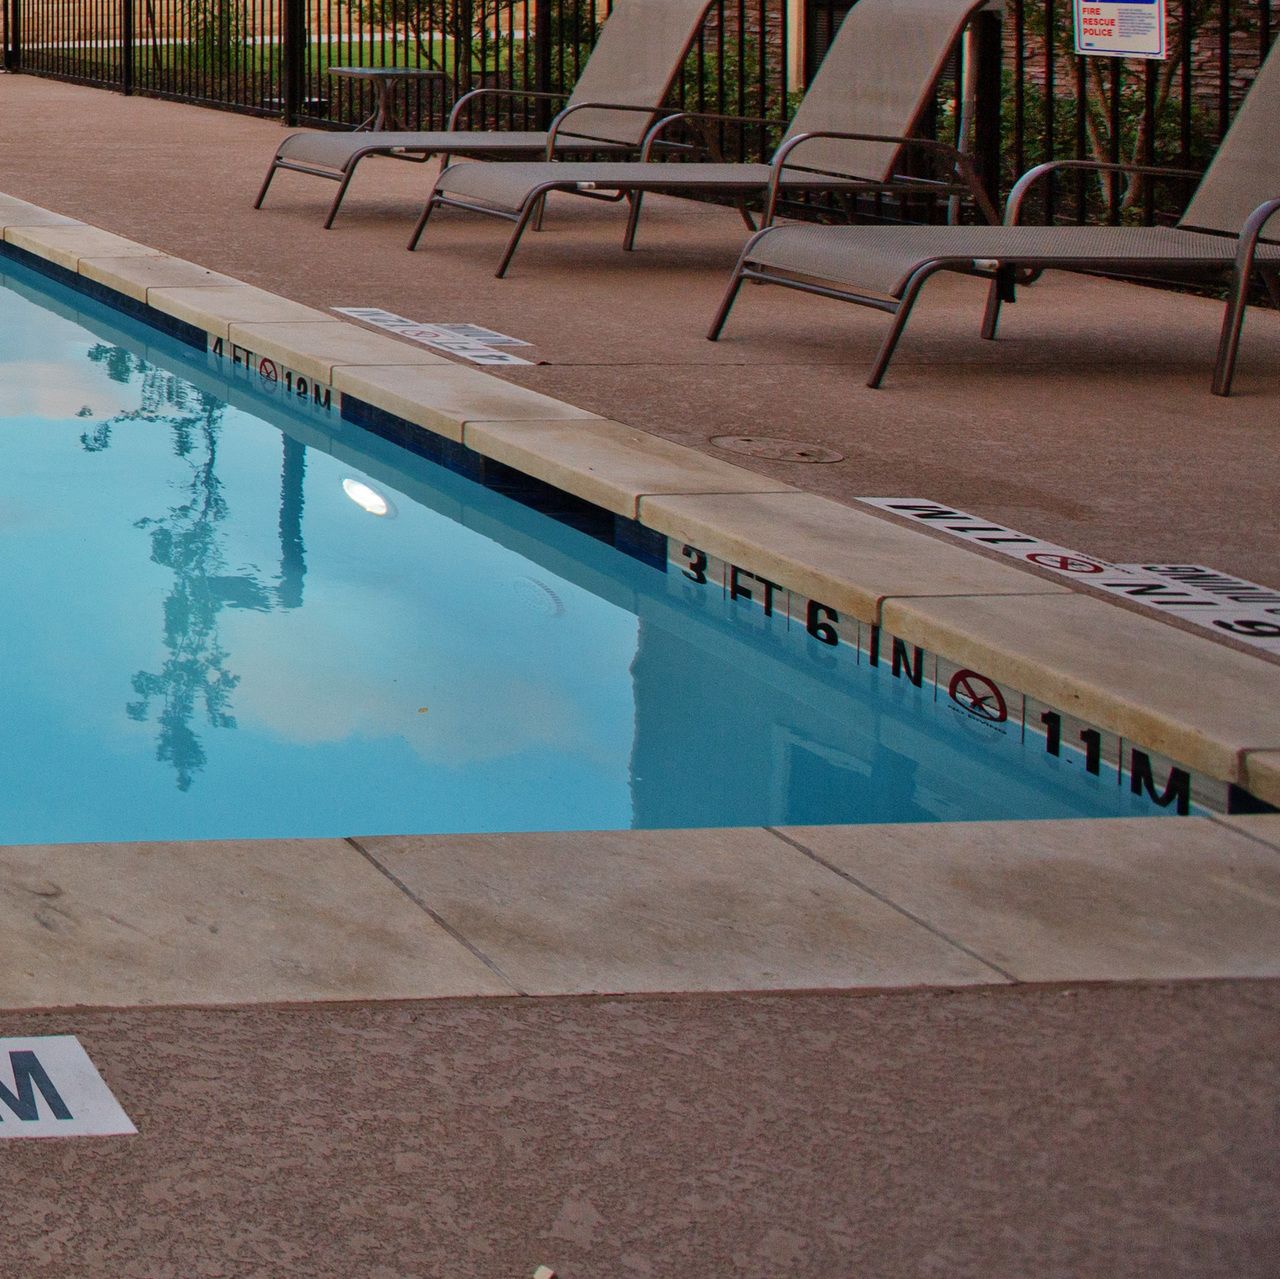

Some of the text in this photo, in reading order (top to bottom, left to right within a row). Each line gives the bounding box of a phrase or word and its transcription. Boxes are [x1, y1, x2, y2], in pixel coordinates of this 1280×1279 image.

[1082, 7, 1101, 16] FIRE
[1082, 18, 1115, 26] RESCUE
[1083, 28, 1113, 37] POLICE
[212, 337, 224, 358] 4
[232, 343, 254, 371] FT
[313, 383, 332, 411] M
[886, 504, 976, 521] M
[1102, 583, 1220, 606] IN
[681, 545, 709, 585] 3
[730, 564, 784, 618] FT
[805, 598, 841, 647] 6
[868, 625, 925, 688] IN
[1129, 748, 1191, 816] M
